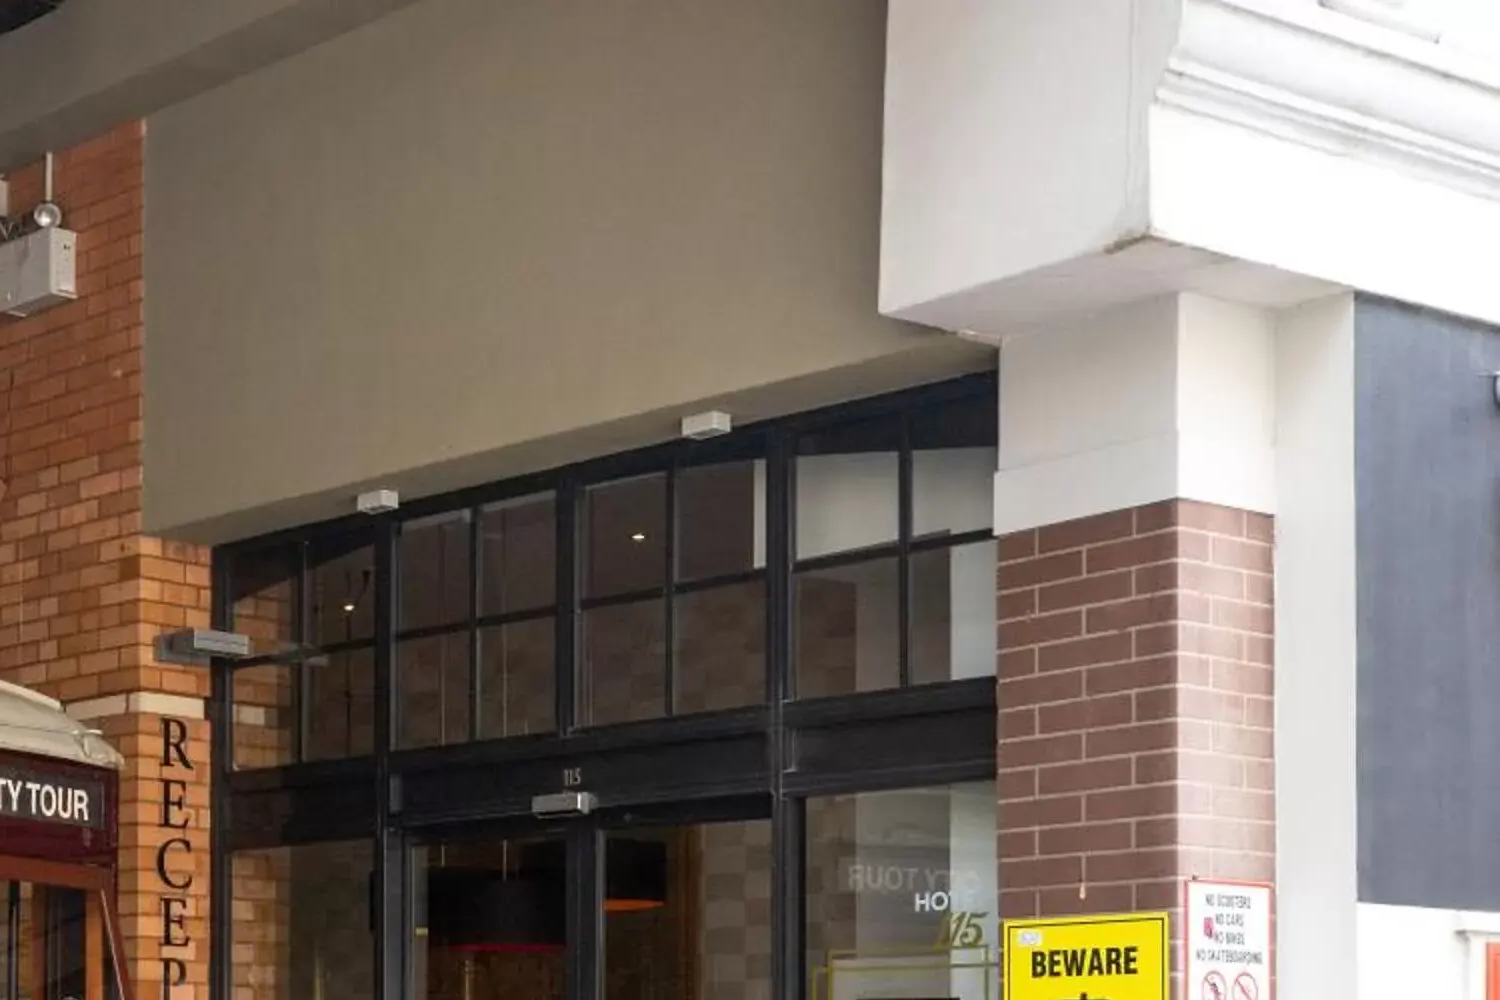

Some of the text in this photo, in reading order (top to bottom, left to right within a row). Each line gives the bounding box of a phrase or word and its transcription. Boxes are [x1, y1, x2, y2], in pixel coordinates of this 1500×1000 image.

[25, 782, 89, 821] TOUR
[1215, 913, 1224, 926] NO
[1031, 946, 1139, 978] BEWARE
